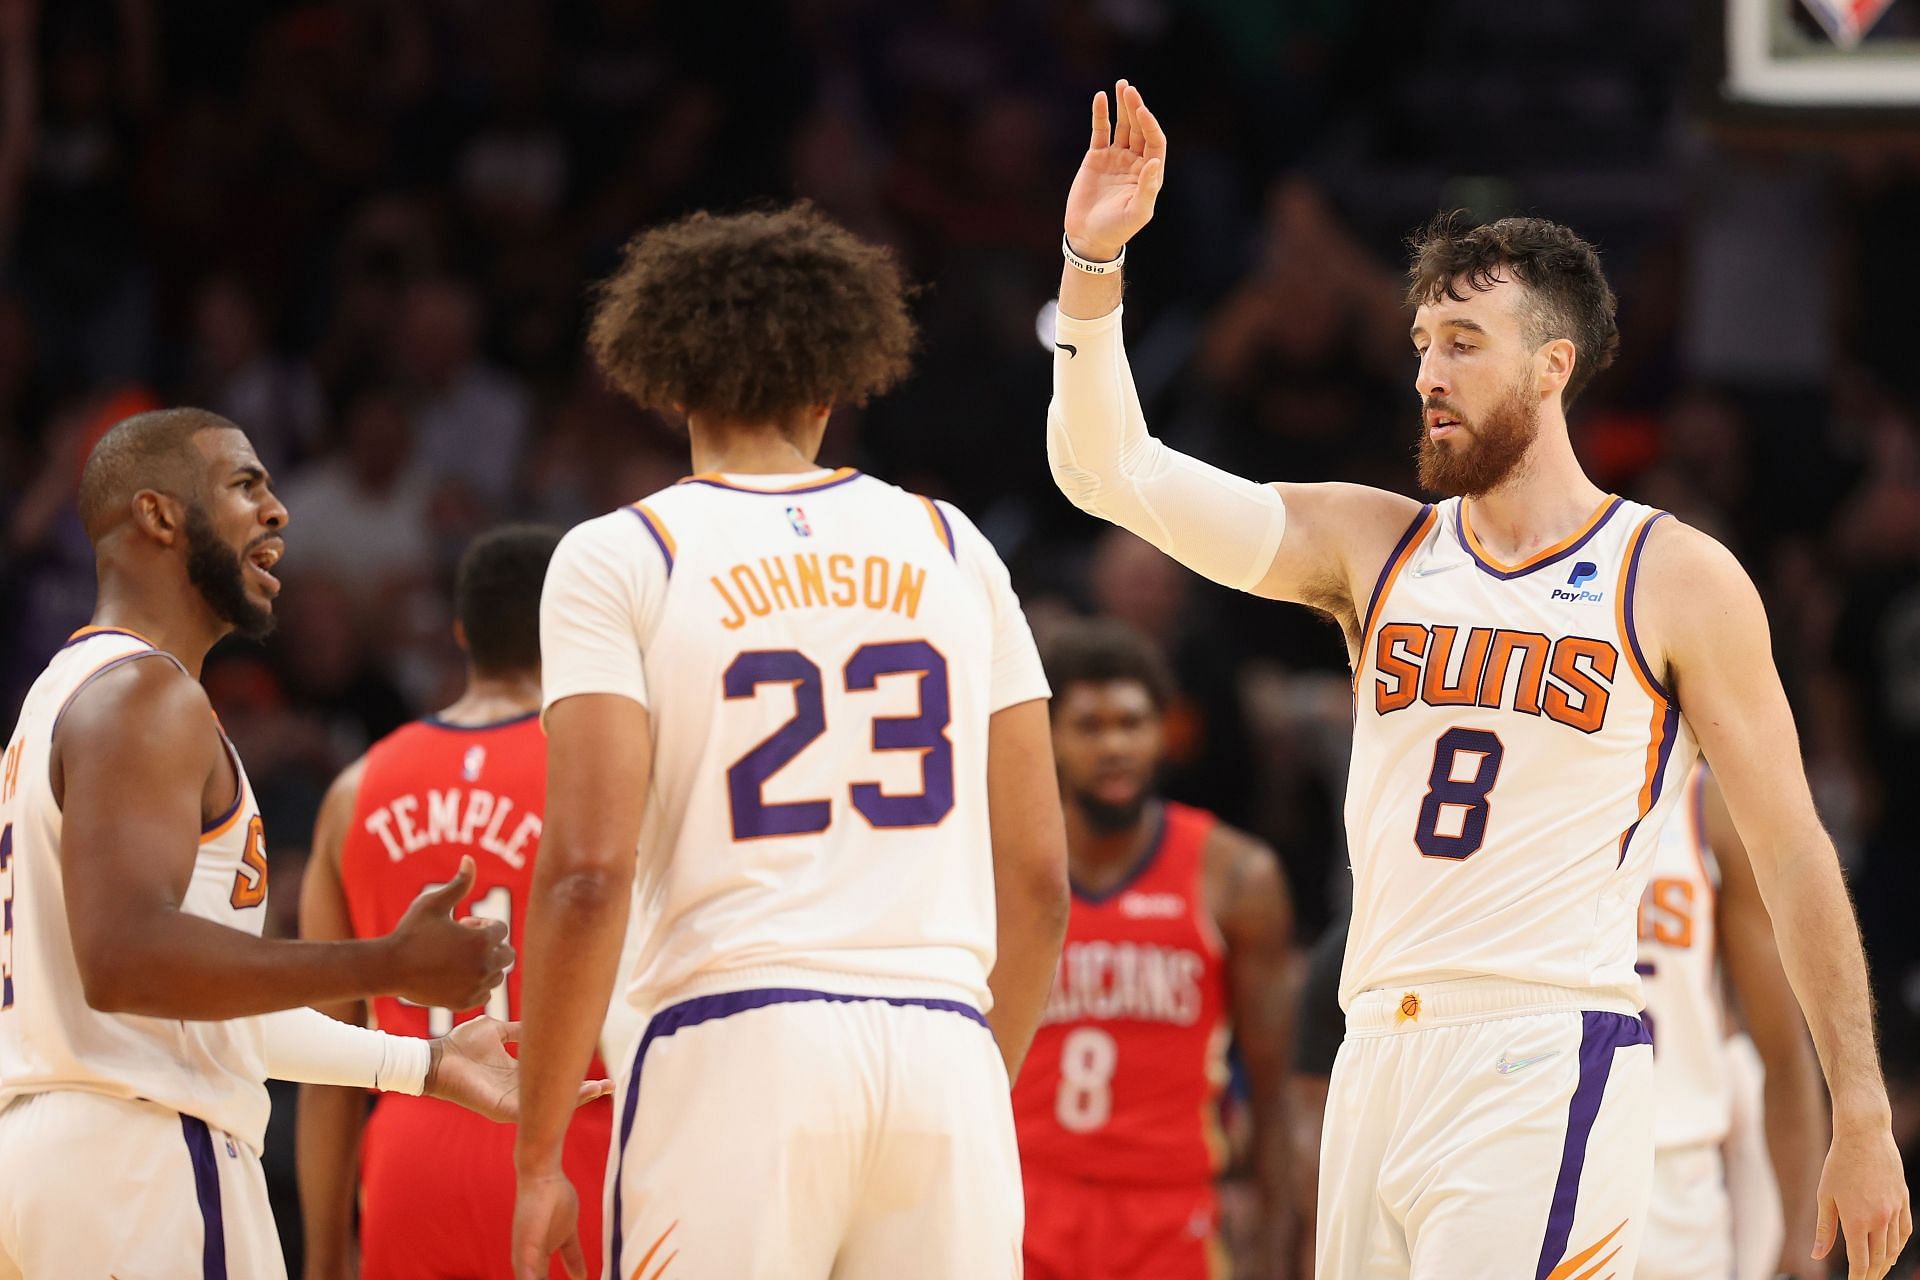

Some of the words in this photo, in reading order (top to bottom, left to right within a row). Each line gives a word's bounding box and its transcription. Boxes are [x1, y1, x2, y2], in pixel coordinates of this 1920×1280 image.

[1085, 264, 1105, 274] Big
[710, 553, 927, 630] JOHNSON
[1551, 589, 1603, 602] PayPal
[1375, 622, 1619, 734] SUNS
[722, 638, 955, 843] 23
[364, 788, 543, 870] TEMPLE
[1413, 725, 1505, 862] 8
[1055, 1028, 1119, 1134] 8
